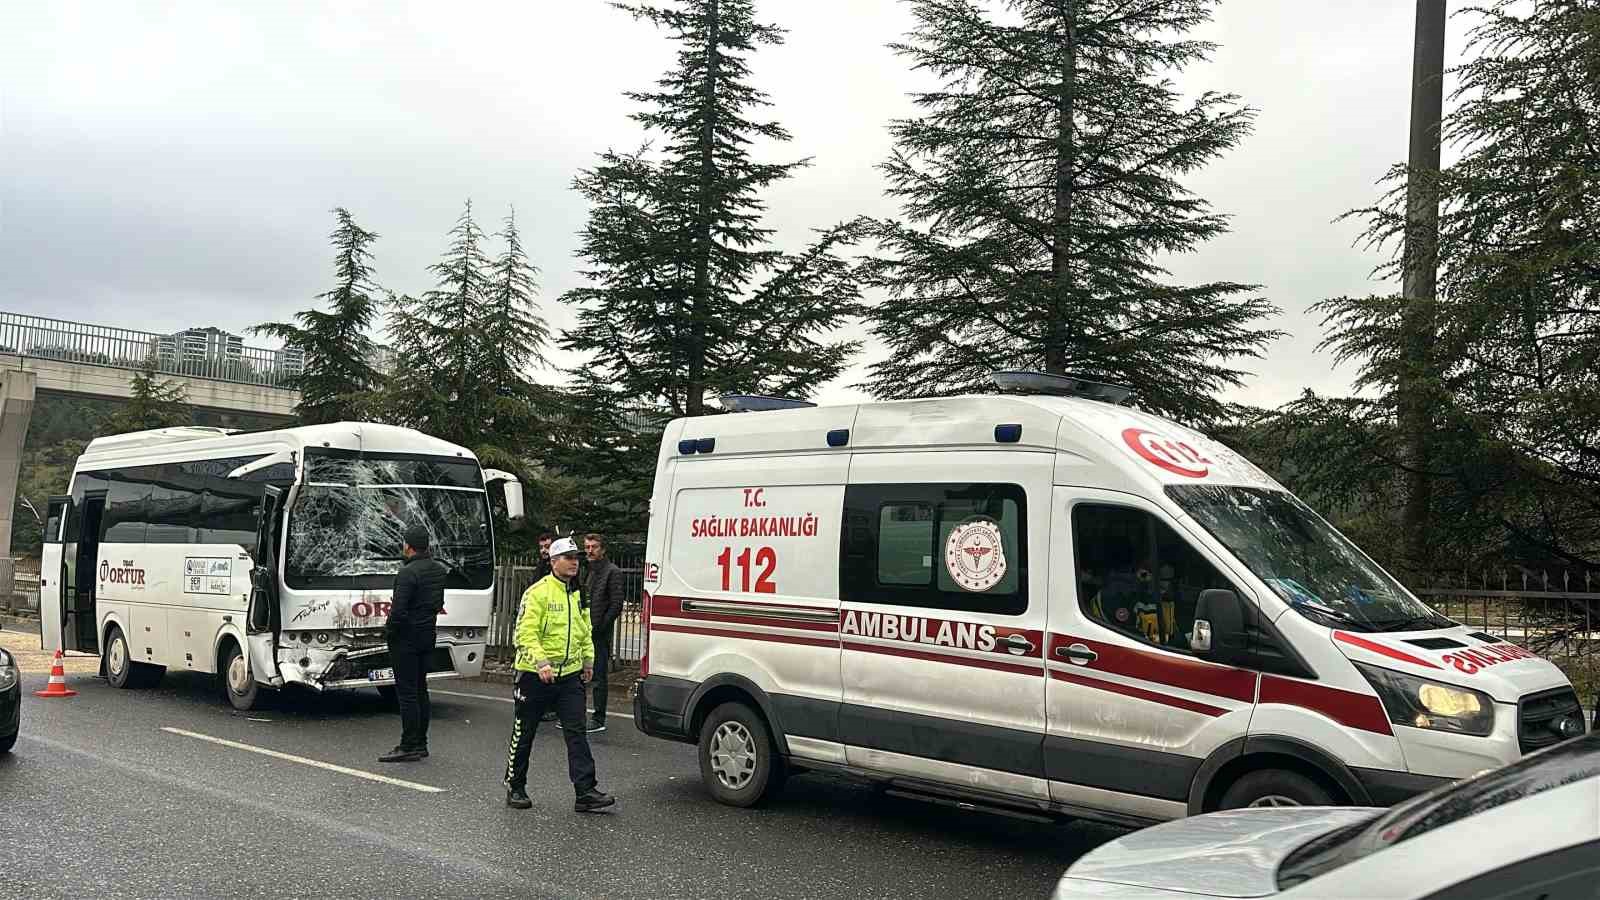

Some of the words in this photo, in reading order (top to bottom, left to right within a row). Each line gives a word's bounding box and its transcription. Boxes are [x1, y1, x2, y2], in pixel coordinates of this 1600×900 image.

[1149, 440, 1214, 465] 112
[743, 488, 766, 507] T.C.
[691, 514, 738, 537] SAĞLIK
[740, 511, 819, 537] BAKANLIĞI
[110, 567, 146, 585] ORTUR
[717, 546, 777, 594] 112
[841, 610, 997, 652] AMBULANS
